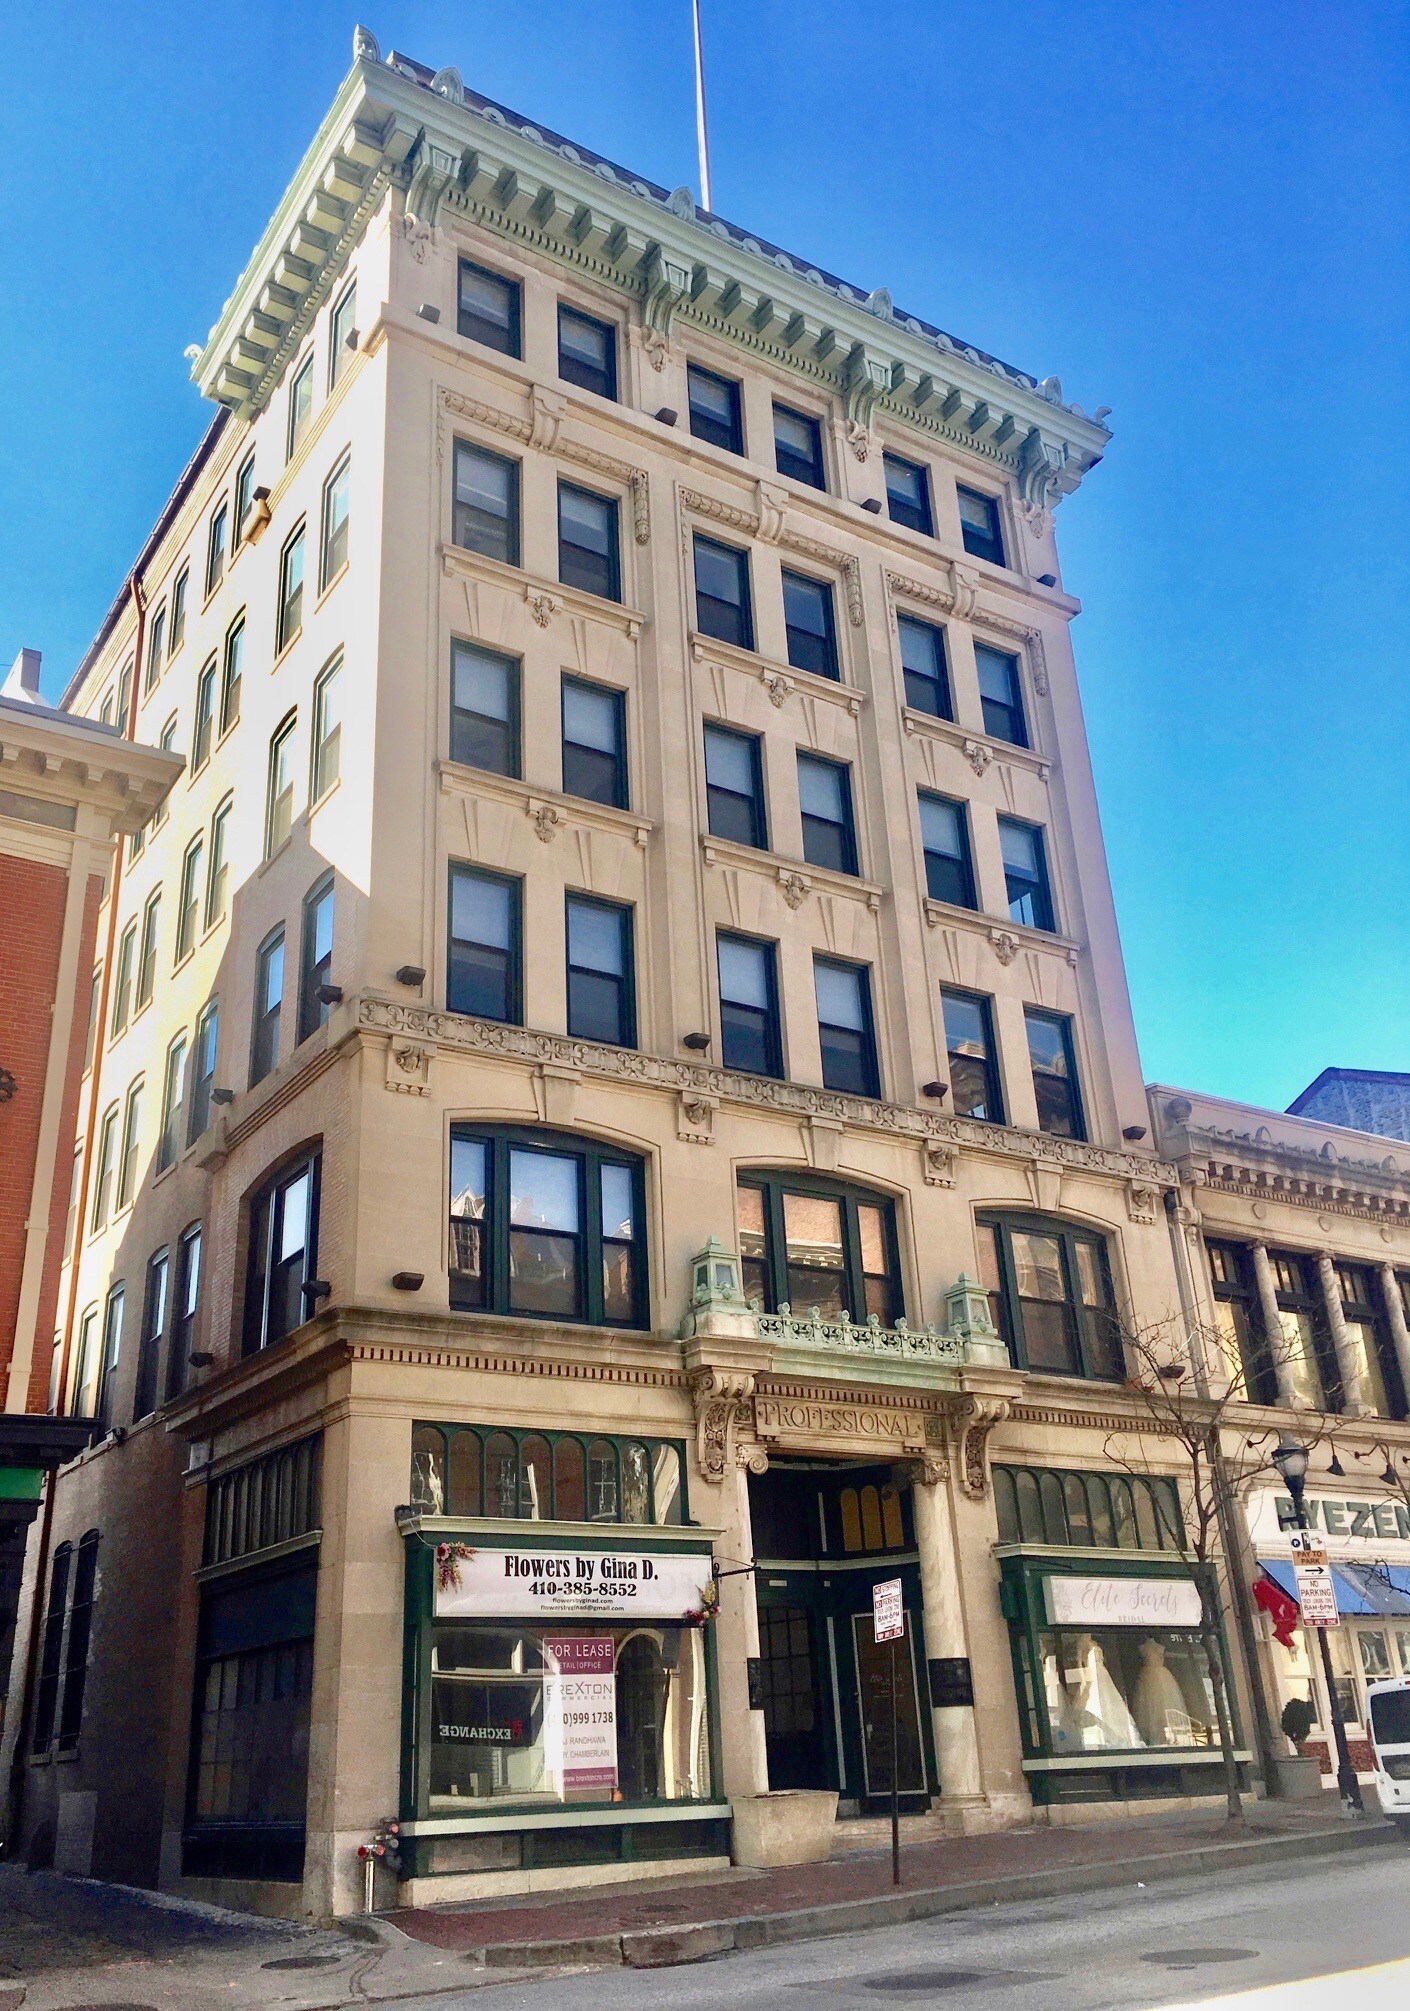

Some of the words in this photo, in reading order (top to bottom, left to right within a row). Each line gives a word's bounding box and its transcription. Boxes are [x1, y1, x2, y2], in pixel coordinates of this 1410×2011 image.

[763, 1402, 918, 1438] PROFESSIONAL
[1297, 1550, 1310, 1558] PAY
[1312, 1550, 1323, 1558] TO
[504, 1555, 571, 1578] Flowers
[575, 1557, 595, 1580] by
[600, 1557, 638, 1580] Gina
[642, 1559, 659, 1580] D.
[528, 1581, 637, 1597] 410-385-8552
[1310, 1580, 1319, 1588] NO
[1081, 1581, 1120, 1612] Elite
[1130, 1583, 1179, 1617] Secrets
[1301, 1589, 1332, 1597] PARKING
[552, 1597, 614, 1605] flowersbyginad.com
[540, 1604, 625, 1612] flowersbyginad@gmail.com
[547, 1644, 571, 1658] FOR
[576, 1644, 612, 1657] LEASE
[592, 1711, 614, 1724] 1738
